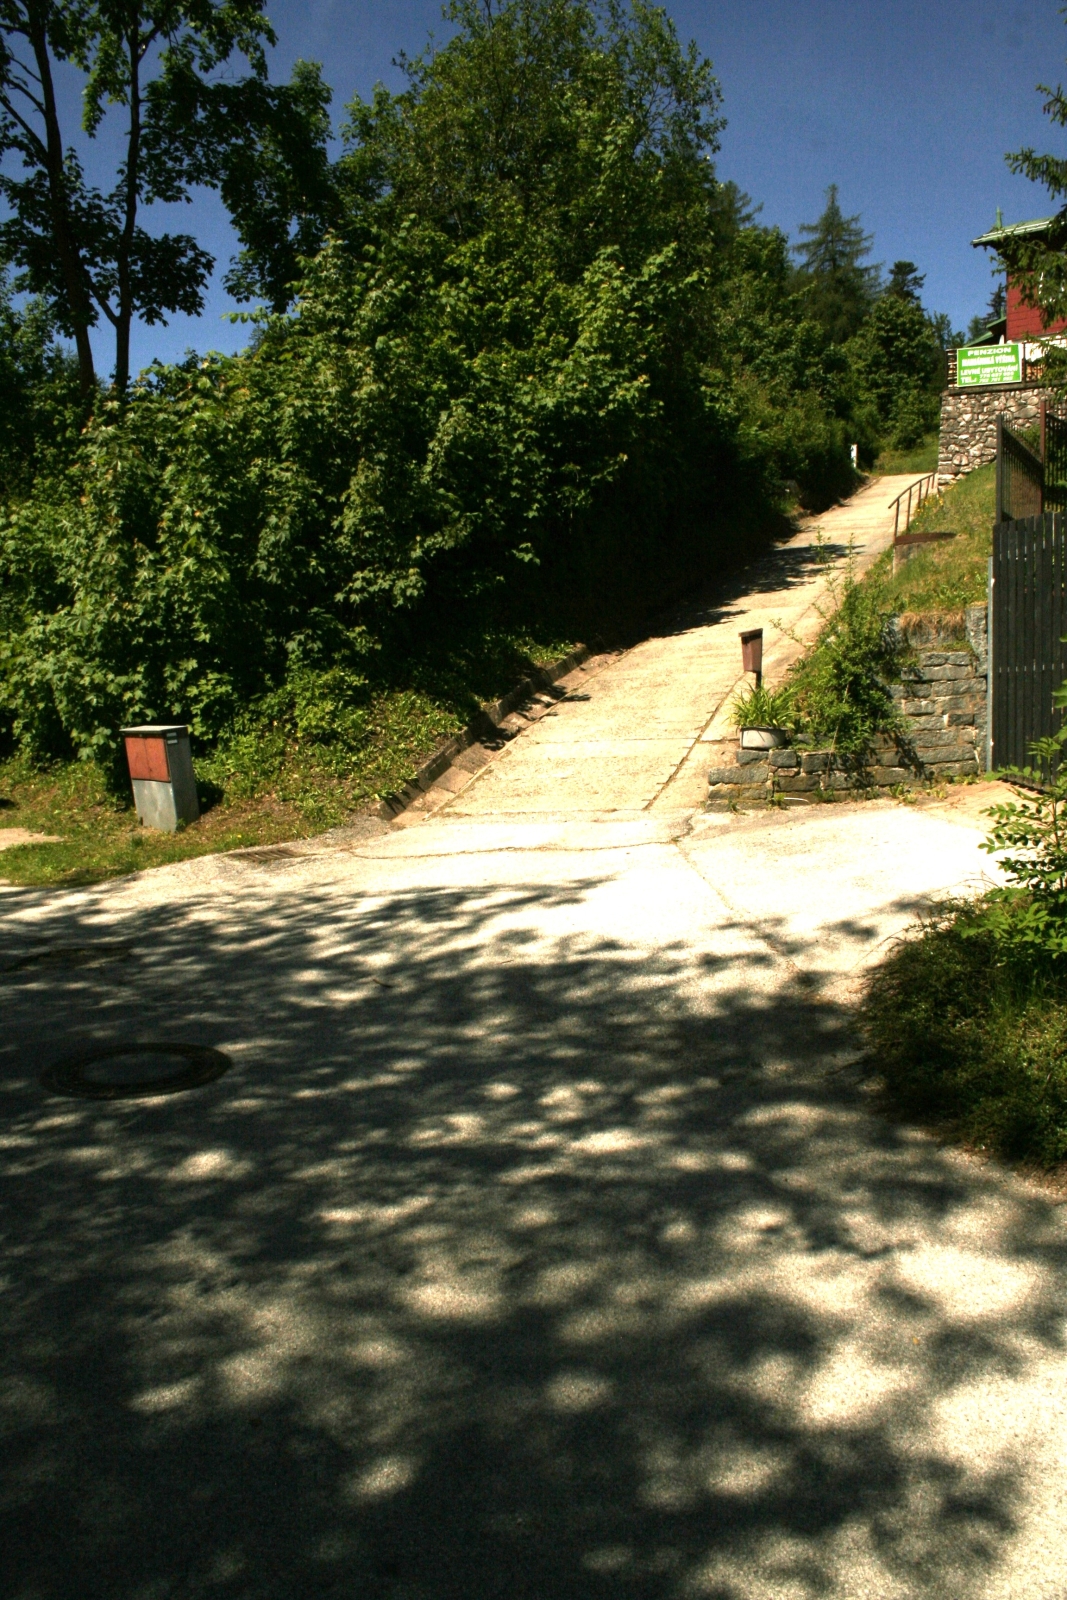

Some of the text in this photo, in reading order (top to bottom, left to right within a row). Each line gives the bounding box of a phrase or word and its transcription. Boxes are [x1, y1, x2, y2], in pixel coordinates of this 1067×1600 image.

[968, 347, 1011, 356] PENZION
[960, 367, 980, 376] LEVNÉ
[981, 364, 1018, 374] UBYTOVÁNÍ
